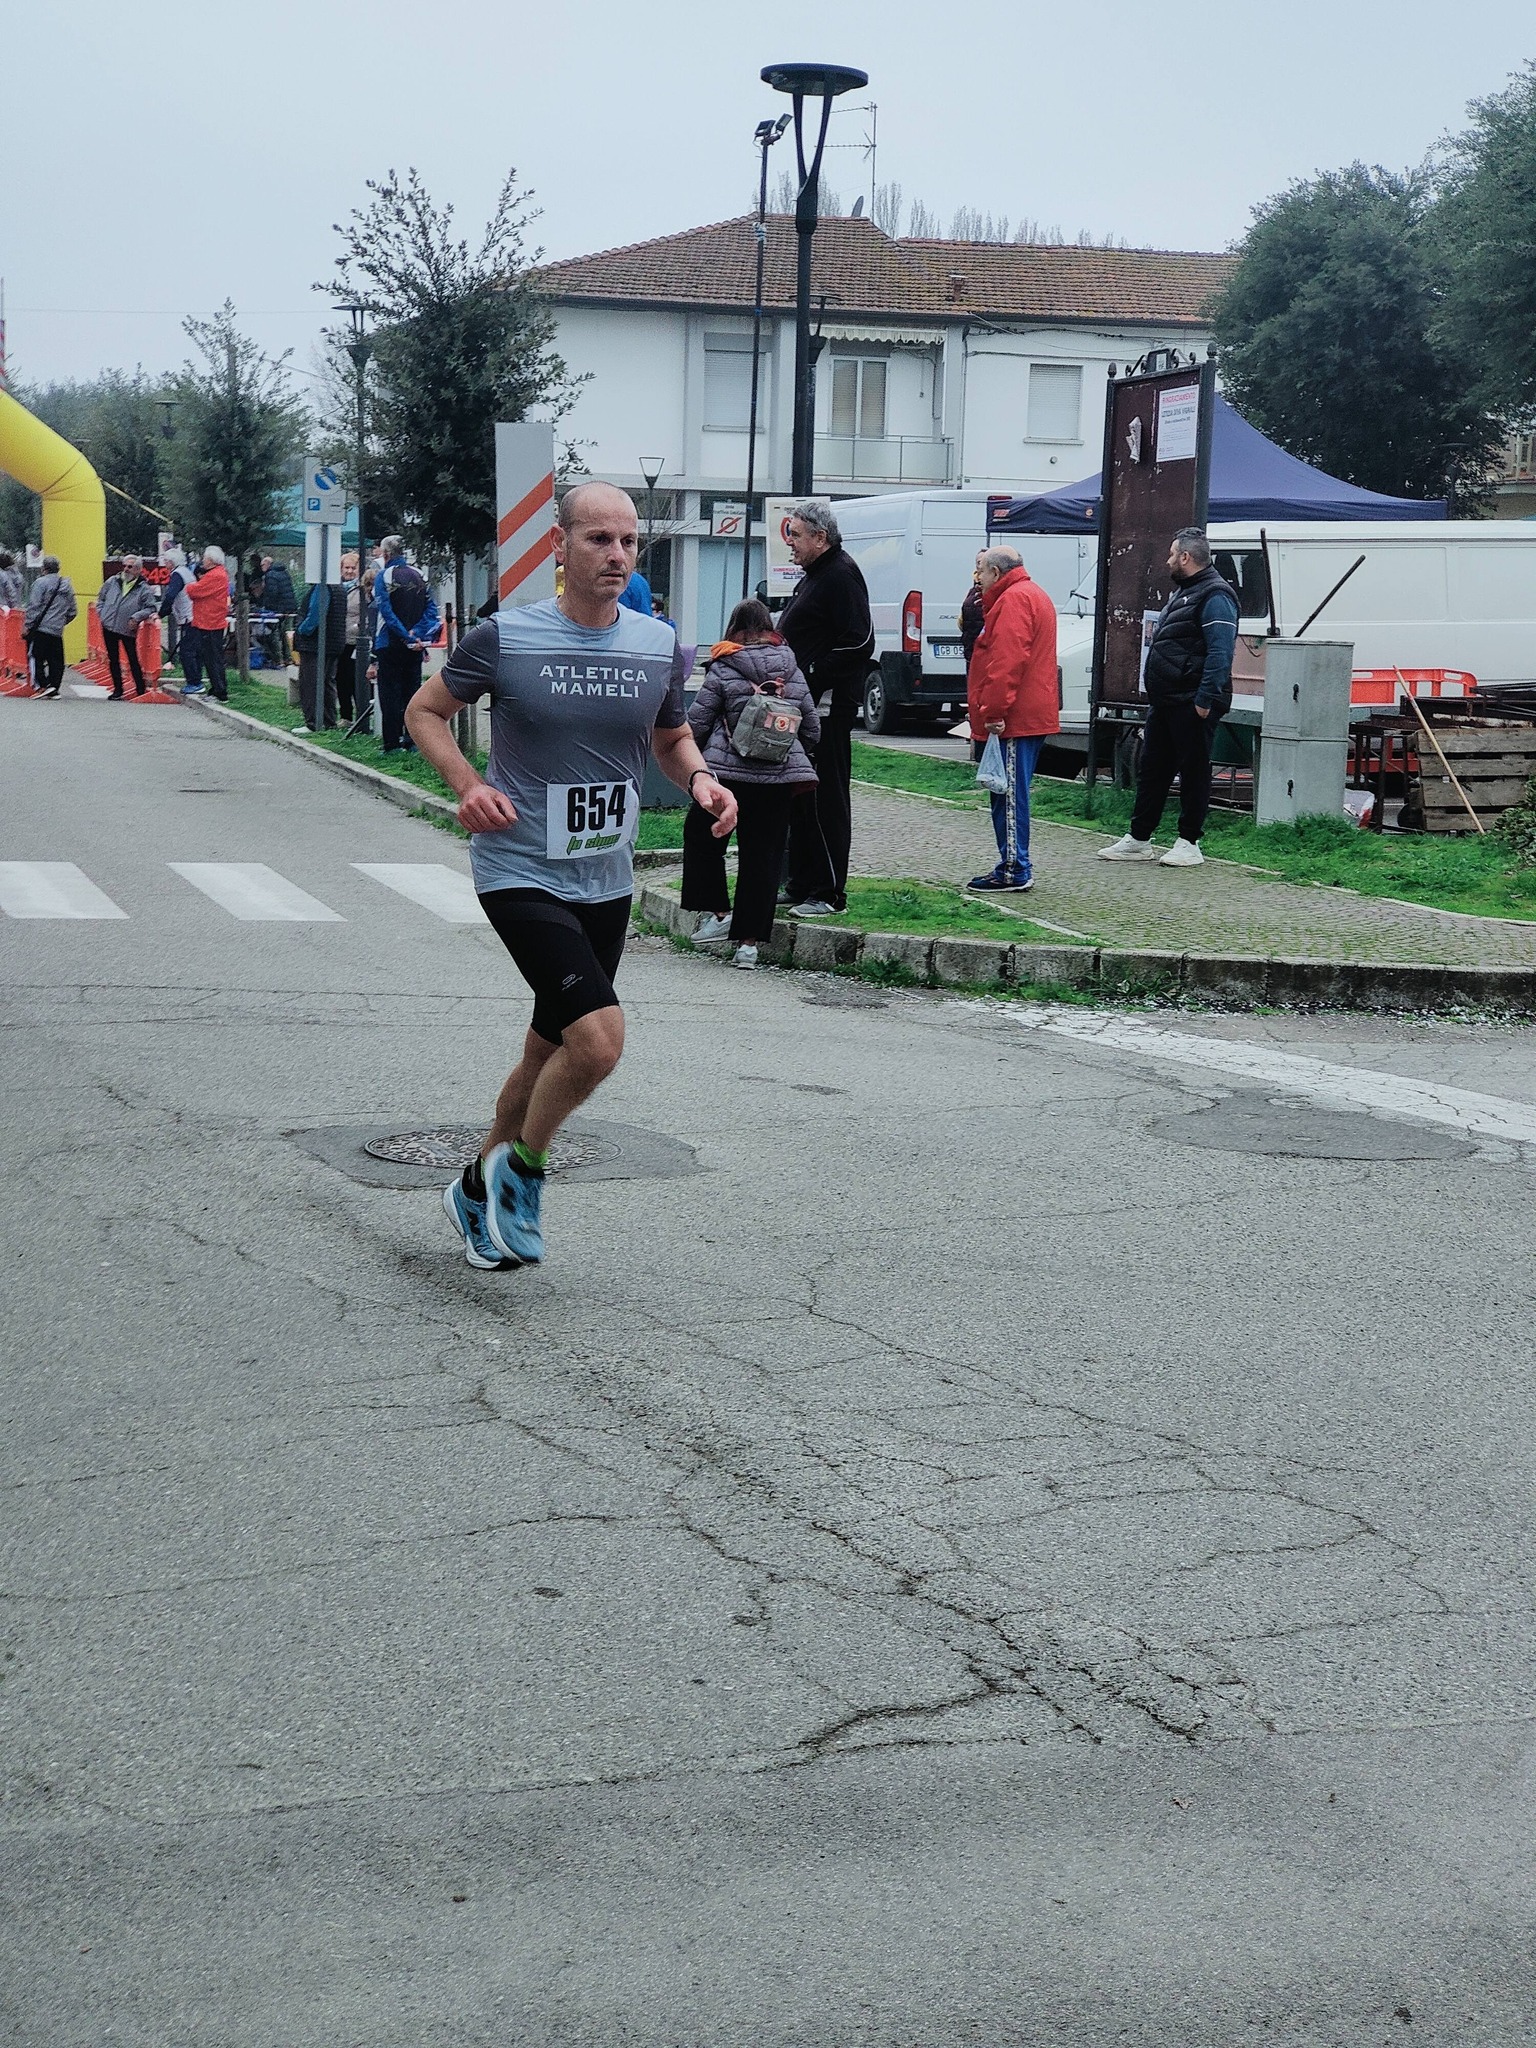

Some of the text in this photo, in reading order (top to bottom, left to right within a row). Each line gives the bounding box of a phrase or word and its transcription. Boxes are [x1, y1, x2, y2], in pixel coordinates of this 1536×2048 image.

[310, 500, 319, 510] P
[539, 665, 648, 683] ATLETICA
[551, 681, 640, 698] MAMELI
[567, 785, 627, 833] 654
